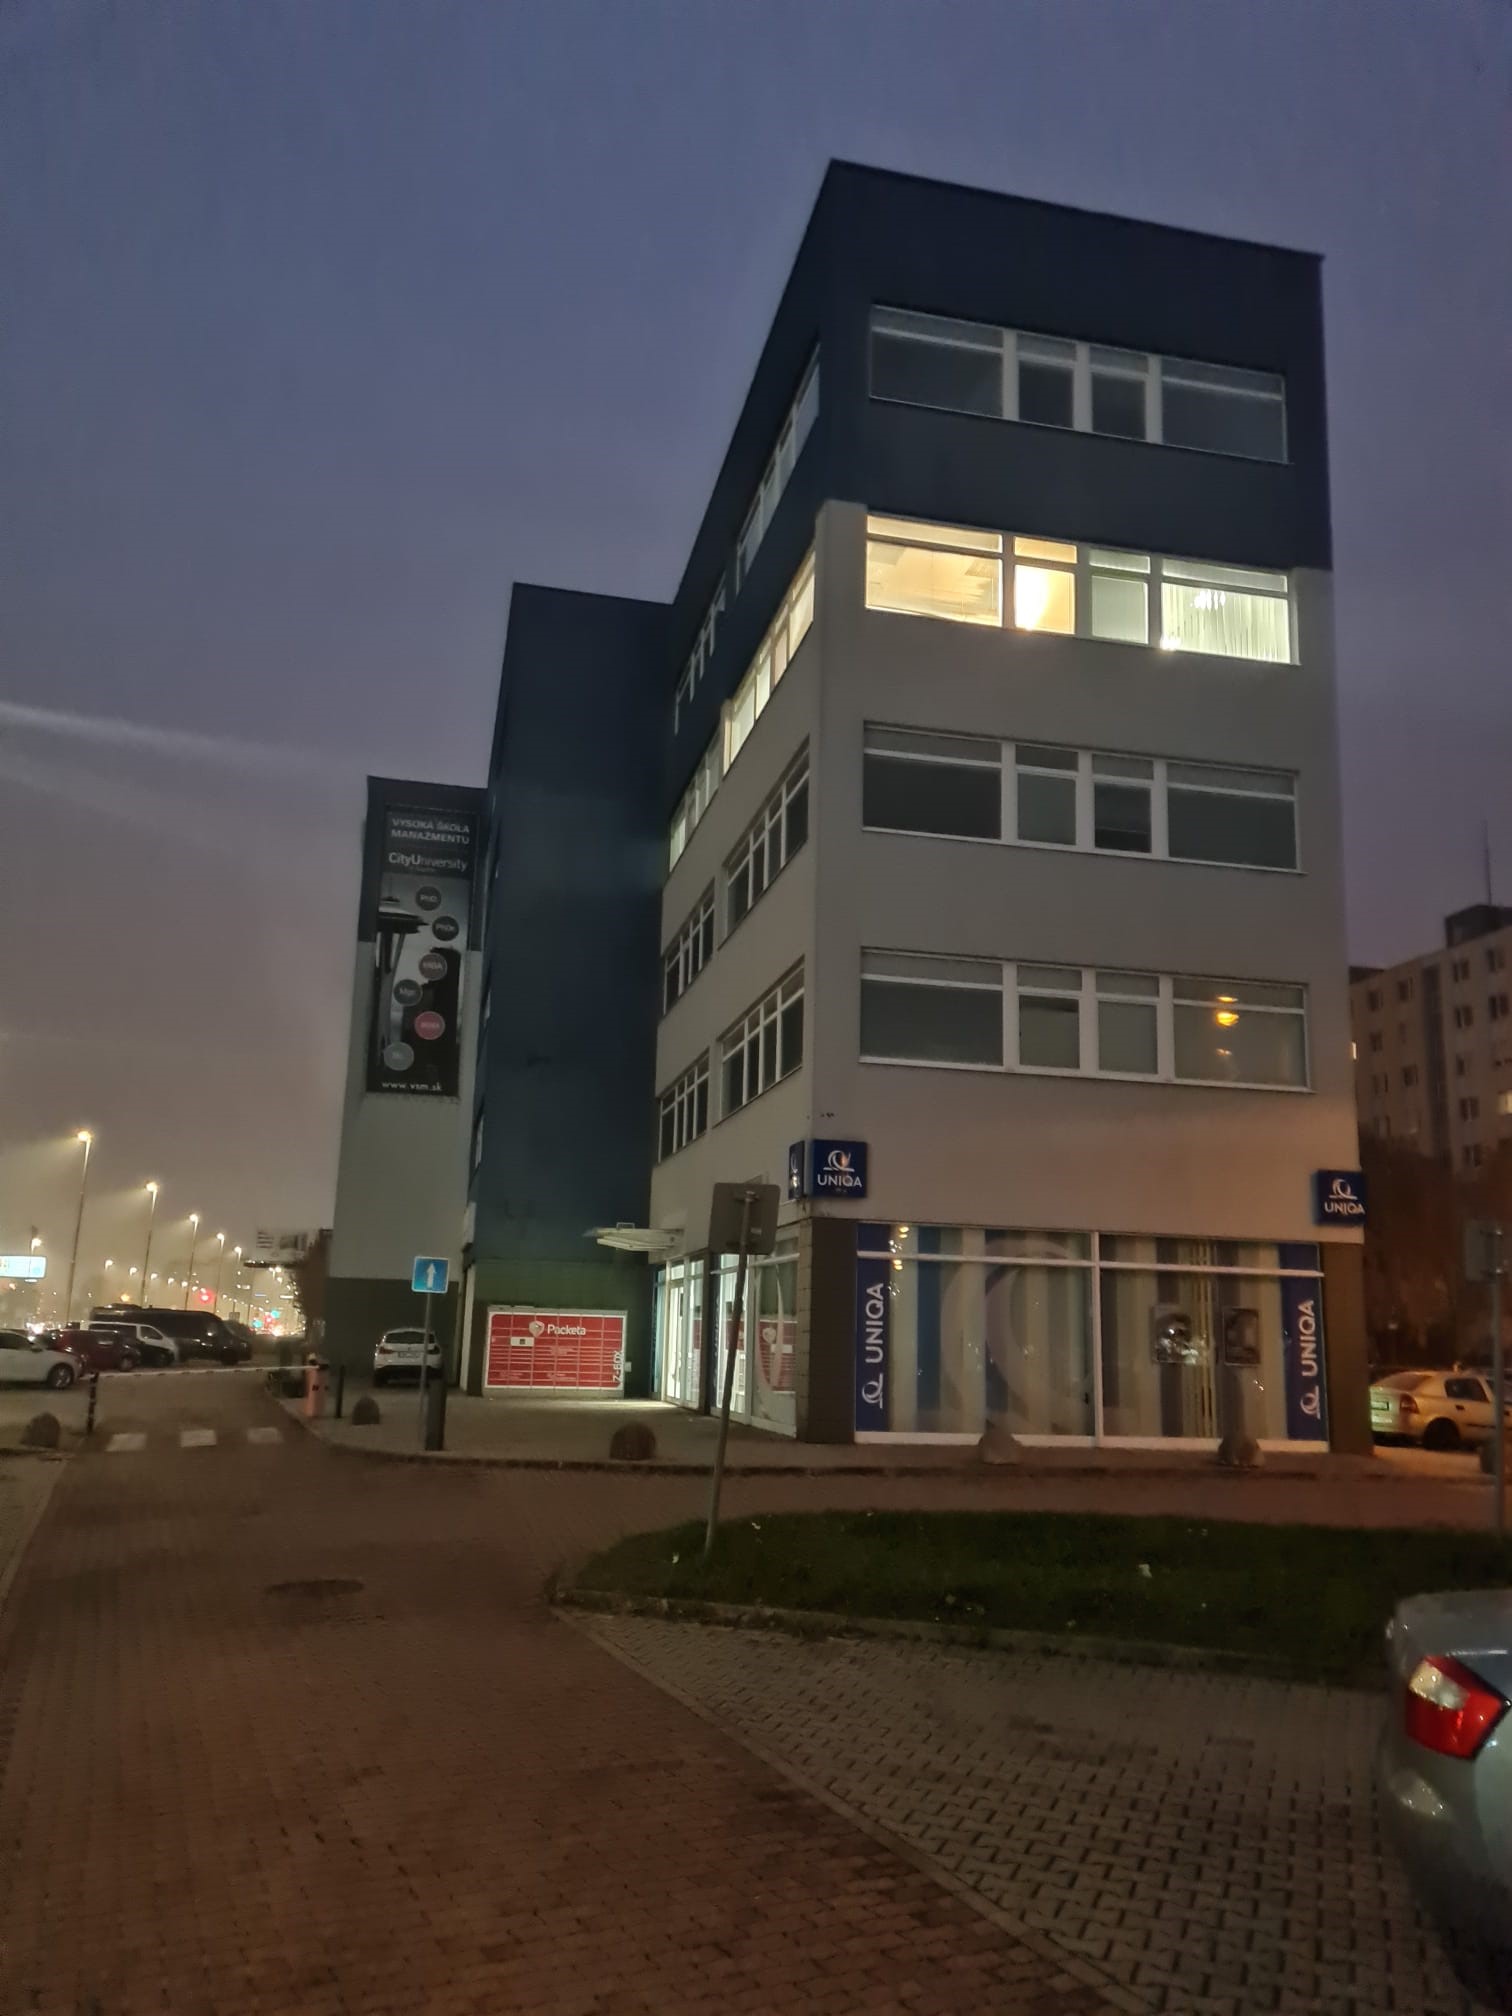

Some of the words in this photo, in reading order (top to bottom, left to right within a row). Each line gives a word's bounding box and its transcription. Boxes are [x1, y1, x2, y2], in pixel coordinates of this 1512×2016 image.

[817, 1173, 862, 1187] UNIQA
[1324, 1201, 1365, 1215] UNIQA
[547, 1324, 587, 1336] Packeta
[865, 1282, 884, 1364] UNIQA
[1297, 1299, 1318, 1377] UNIQA
